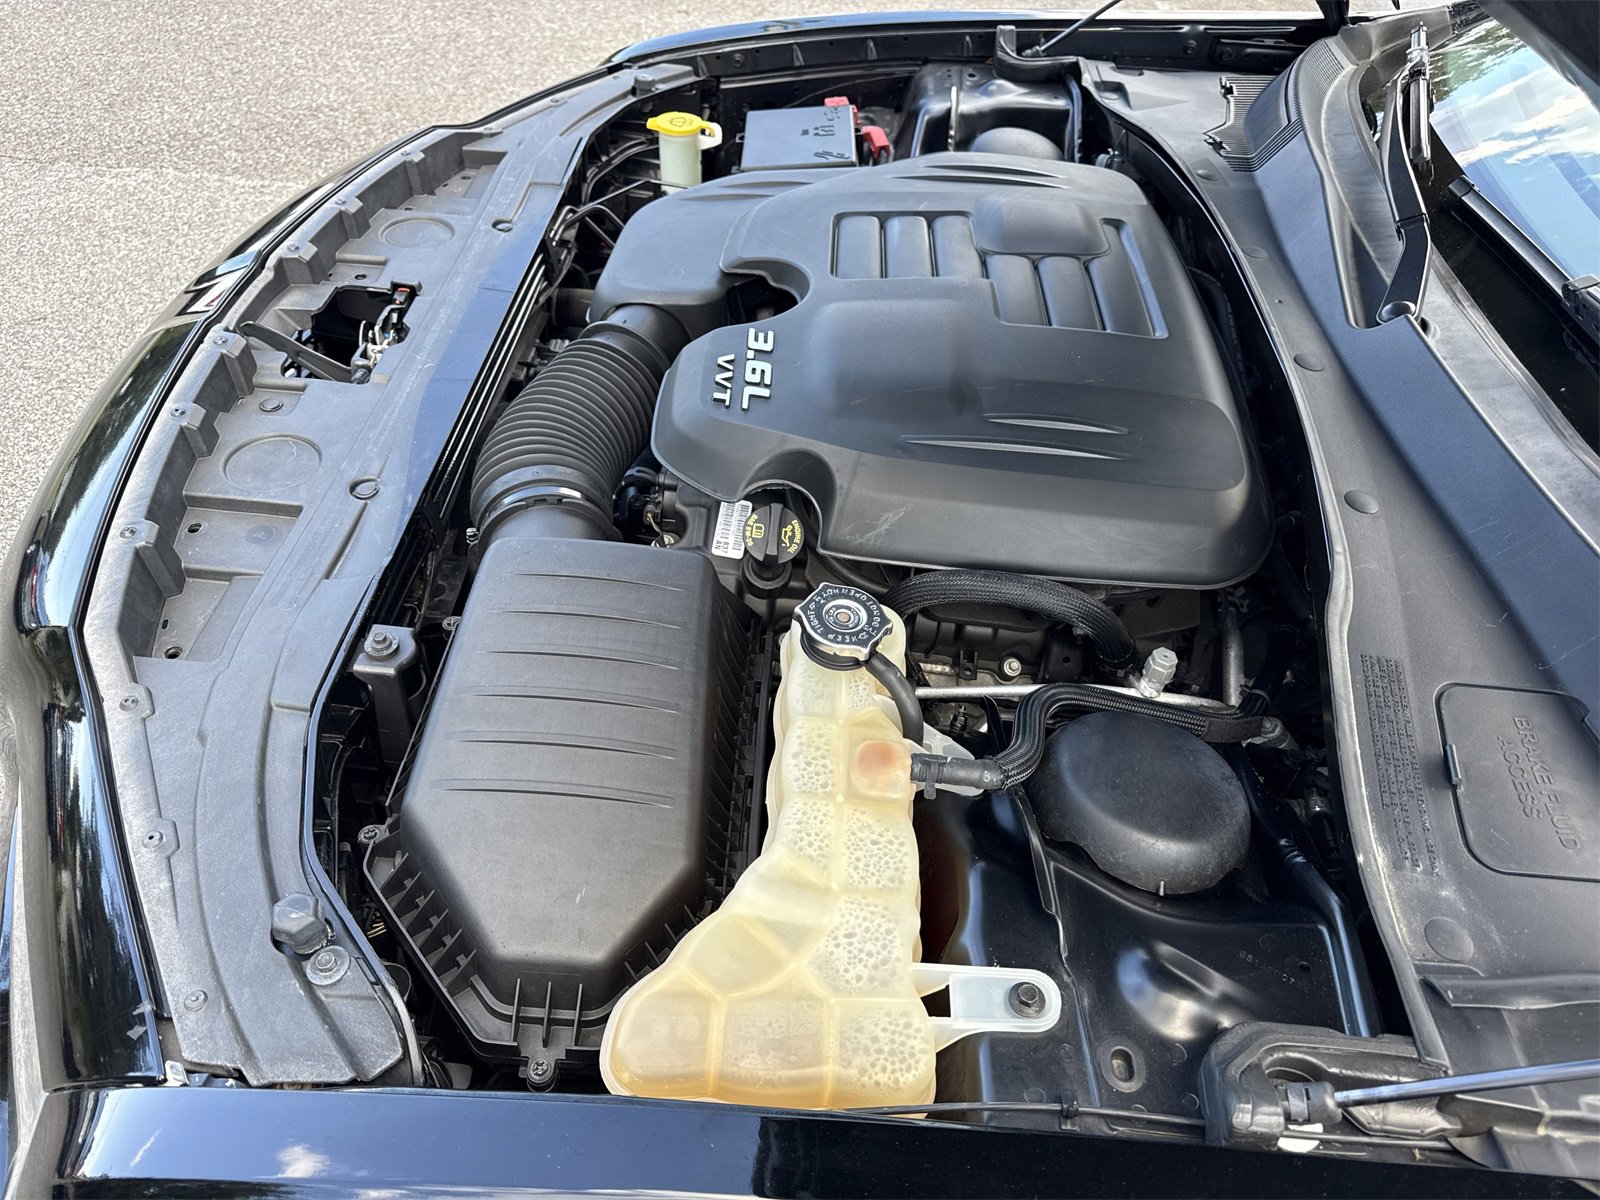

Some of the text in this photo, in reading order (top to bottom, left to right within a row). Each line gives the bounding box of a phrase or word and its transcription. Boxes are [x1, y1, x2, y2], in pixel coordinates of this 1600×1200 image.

[713, 354, 735, 408] VVT
[742, 328, 774, 411] 3.6L
[745, 514, 758, 546] SAE 5W-20
[787, 519, 801, 554] ENGINE OIL
[841, 588, 867, 601] OPEN
[866, 601, 880, 616] NOT
[807, 610, 858, 643] KEEP TIGHT
[1496, 735, 1542, 818] ACCESS
[1513, 716, 1581, 851] BRAKE FLUID
